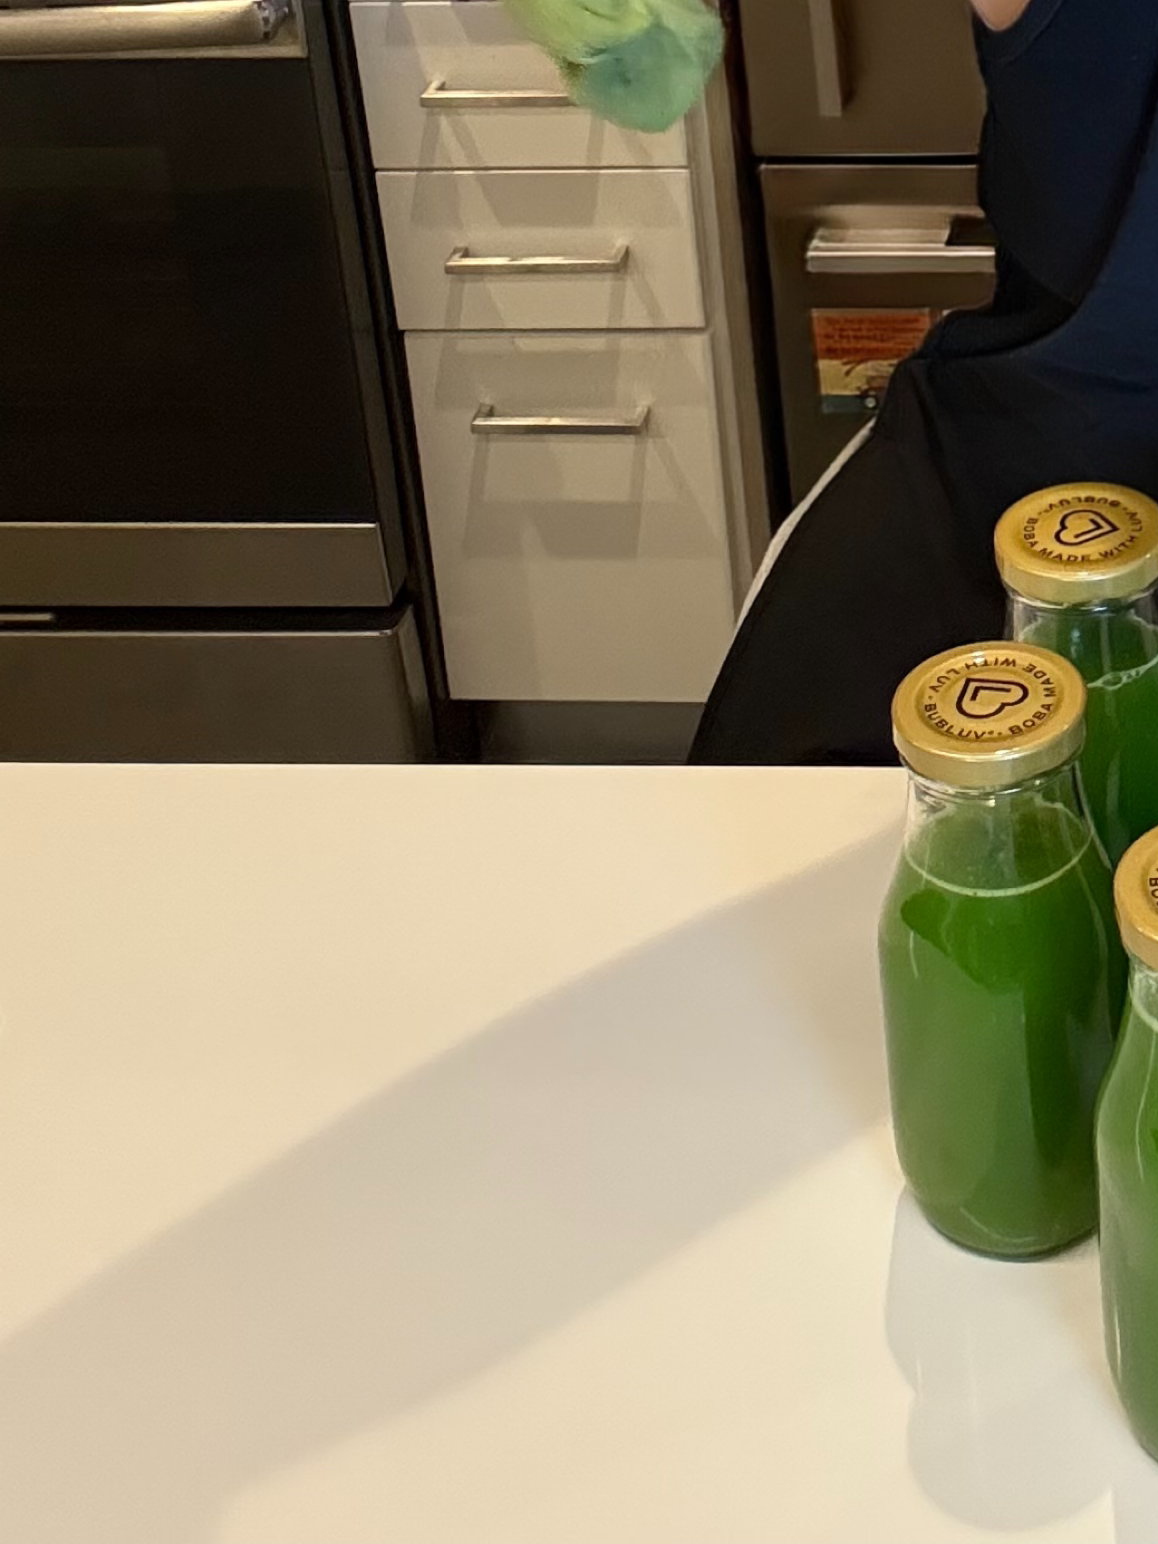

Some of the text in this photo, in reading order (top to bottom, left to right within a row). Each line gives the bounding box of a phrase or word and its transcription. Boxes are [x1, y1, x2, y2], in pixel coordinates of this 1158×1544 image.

[1023, 509, 1144, 563] BOBA MADE WITH LUV
[928, 656, 1057, 736] BOBA MADE WITH LUV
